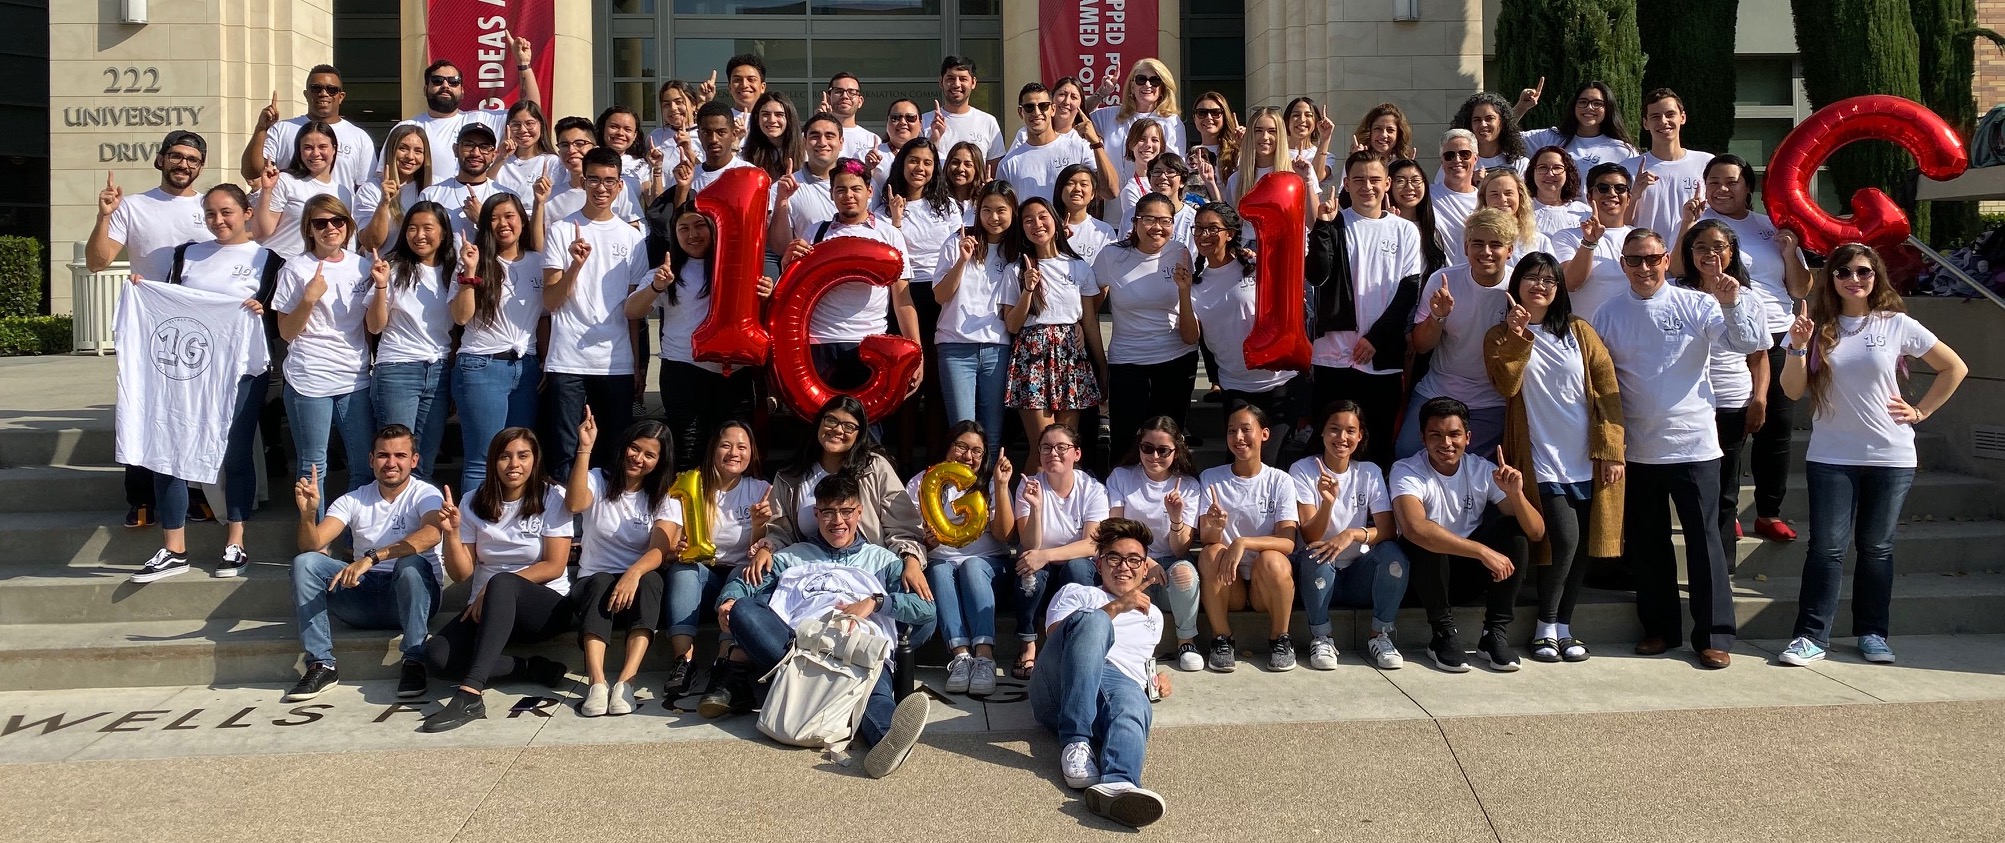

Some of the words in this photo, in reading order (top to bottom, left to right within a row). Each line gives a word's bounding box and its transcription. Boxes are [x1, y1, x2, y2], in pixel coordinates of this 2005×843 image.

[477, 15, 507, 89] IDEAS
[103, 66, 162, 93] 222
[63, 106, 204, 127] UNIVERSITY
[1053, 157, 1070, 168] 1G
[611, 243, 627, 256] 1G
[1078, 243, 1094, 257] 1G
[1381, 239, 1398, 254] 1G
[1060, 274, 1076, 286] 1G
[1660, 315, 1684, 331] 1G
[157, 326, 208, 369] 1G
[1863, 333, 1887, 347] 1G
[1258, 495, 1276, 513] 1G
[1351, 491, 1366, 507] 1G
[634, 510, 651, 526] 1G
[735, 505, 751, 521] 1G
[519, 518, 542, 535] 1G
[0, 704, 335, 737] WELLS
